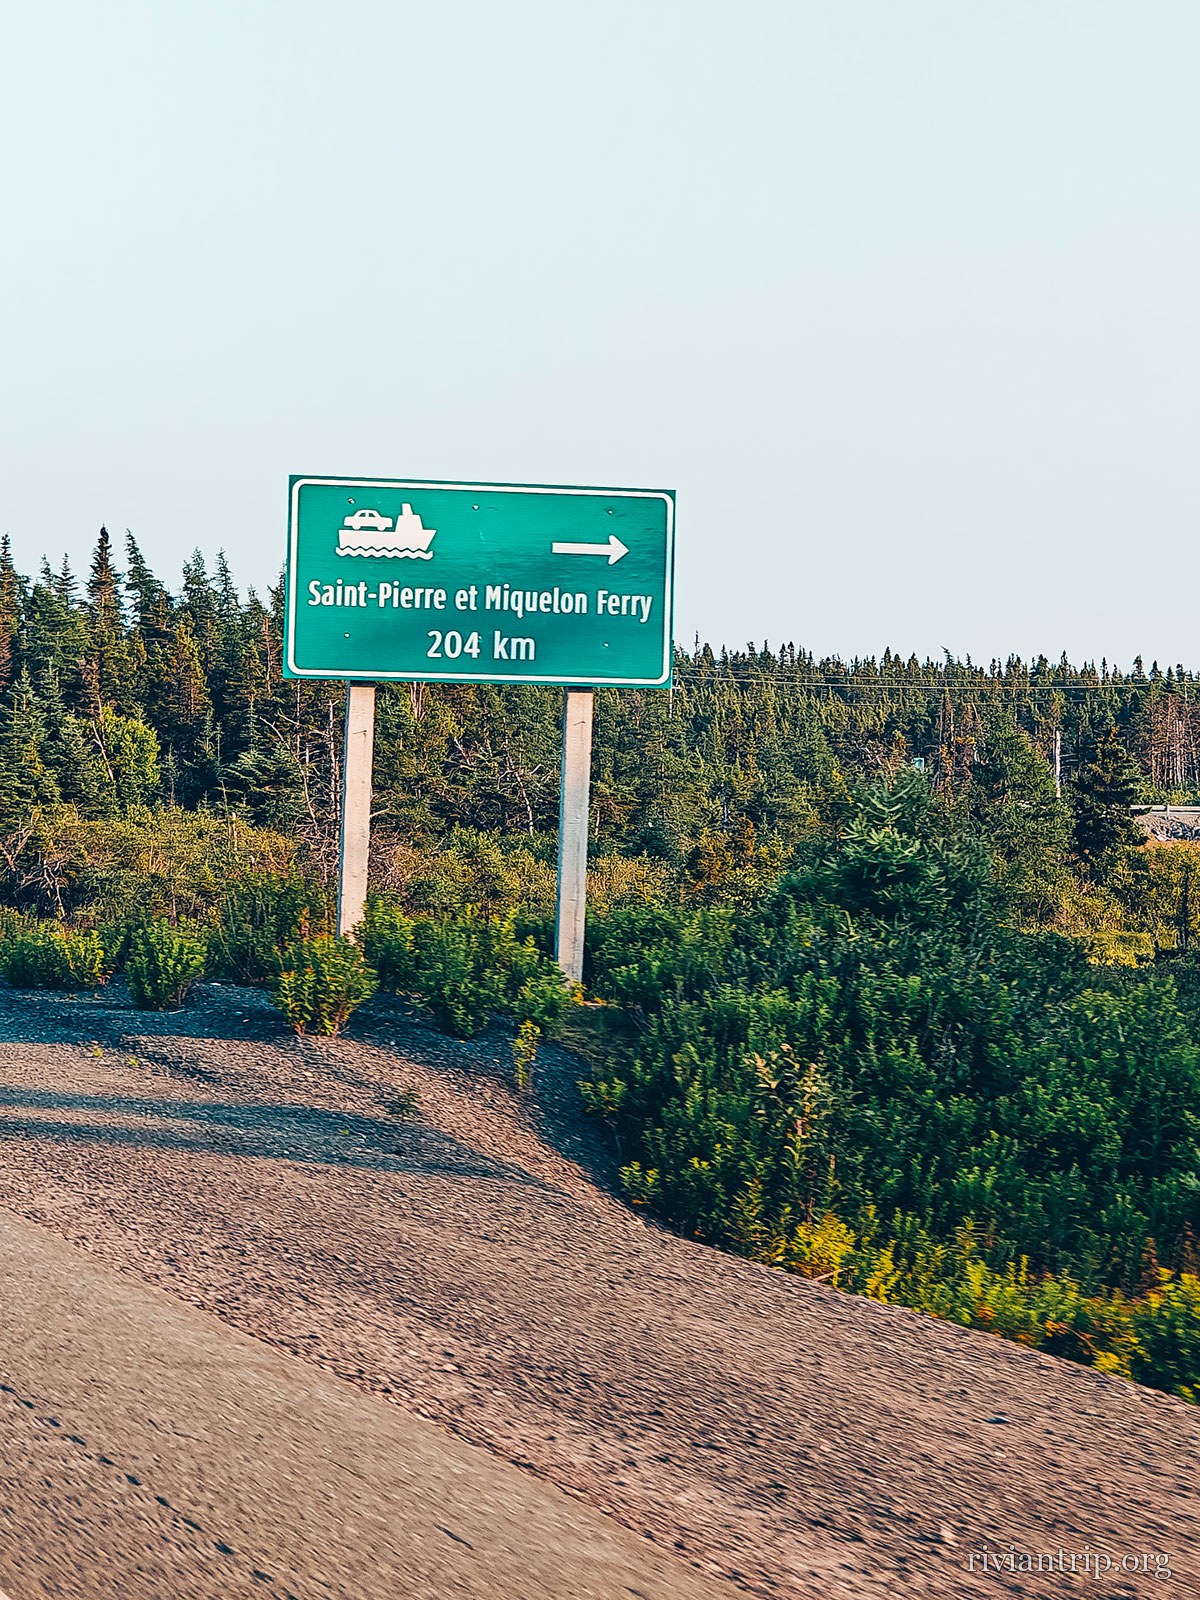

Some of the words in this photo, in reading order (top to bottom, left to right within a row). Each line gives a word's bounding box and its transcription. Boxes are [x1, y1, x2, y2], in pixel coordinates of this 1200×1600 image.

[308, 579, 446, 610] Saint-Pierre
[455, 585, 478, 611] et
[485, 583, 587, 619] Miquelon
[597, 590, 652, 623] Ferry
[427, 630, 481, 659] 204
[493, 630, 536, 661] km
